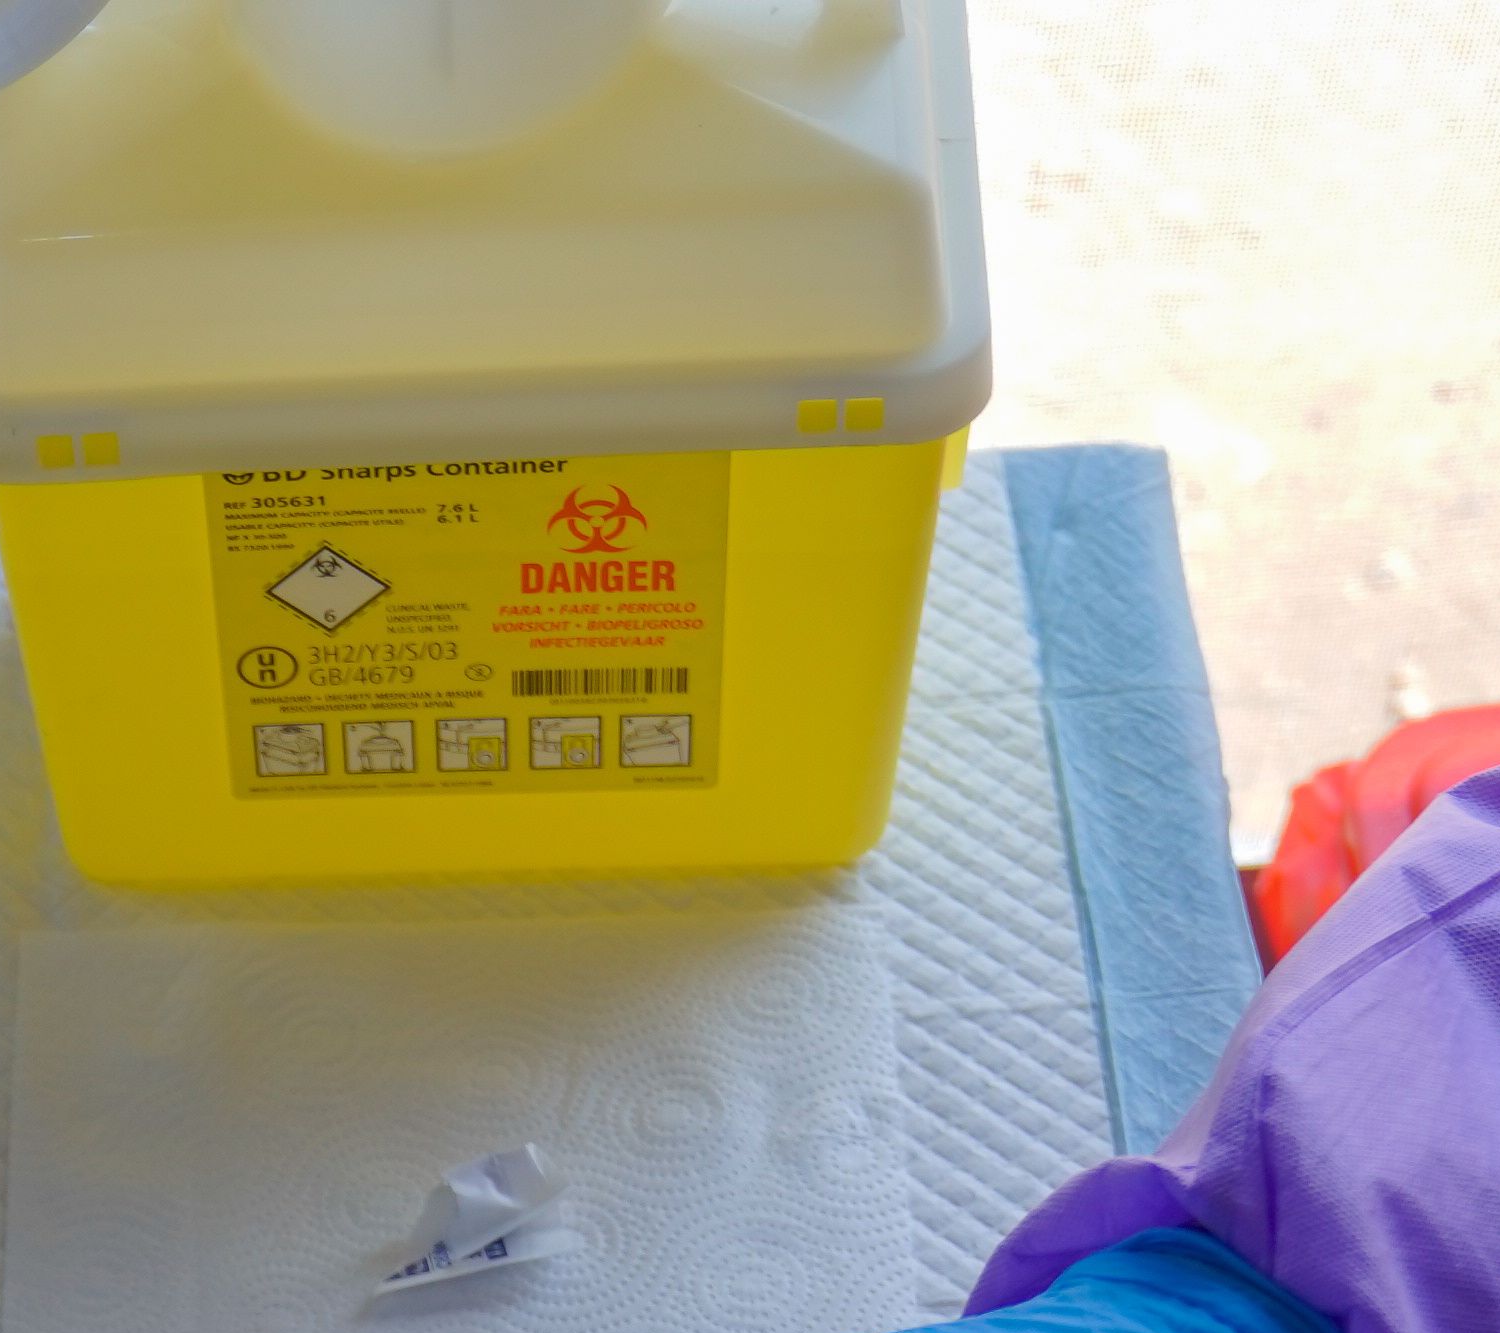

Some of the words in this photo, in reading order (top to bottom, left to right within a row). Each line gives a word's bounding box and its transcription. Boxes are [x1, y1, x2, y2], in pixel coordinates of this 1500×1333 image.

[250, 494, 326, 509] 305631
[518, 558, 677, 596] DANGER
[306, 639, 459, 665] 3H2/Y3/S/03
[307, 664, 416, 687] GB/4679
